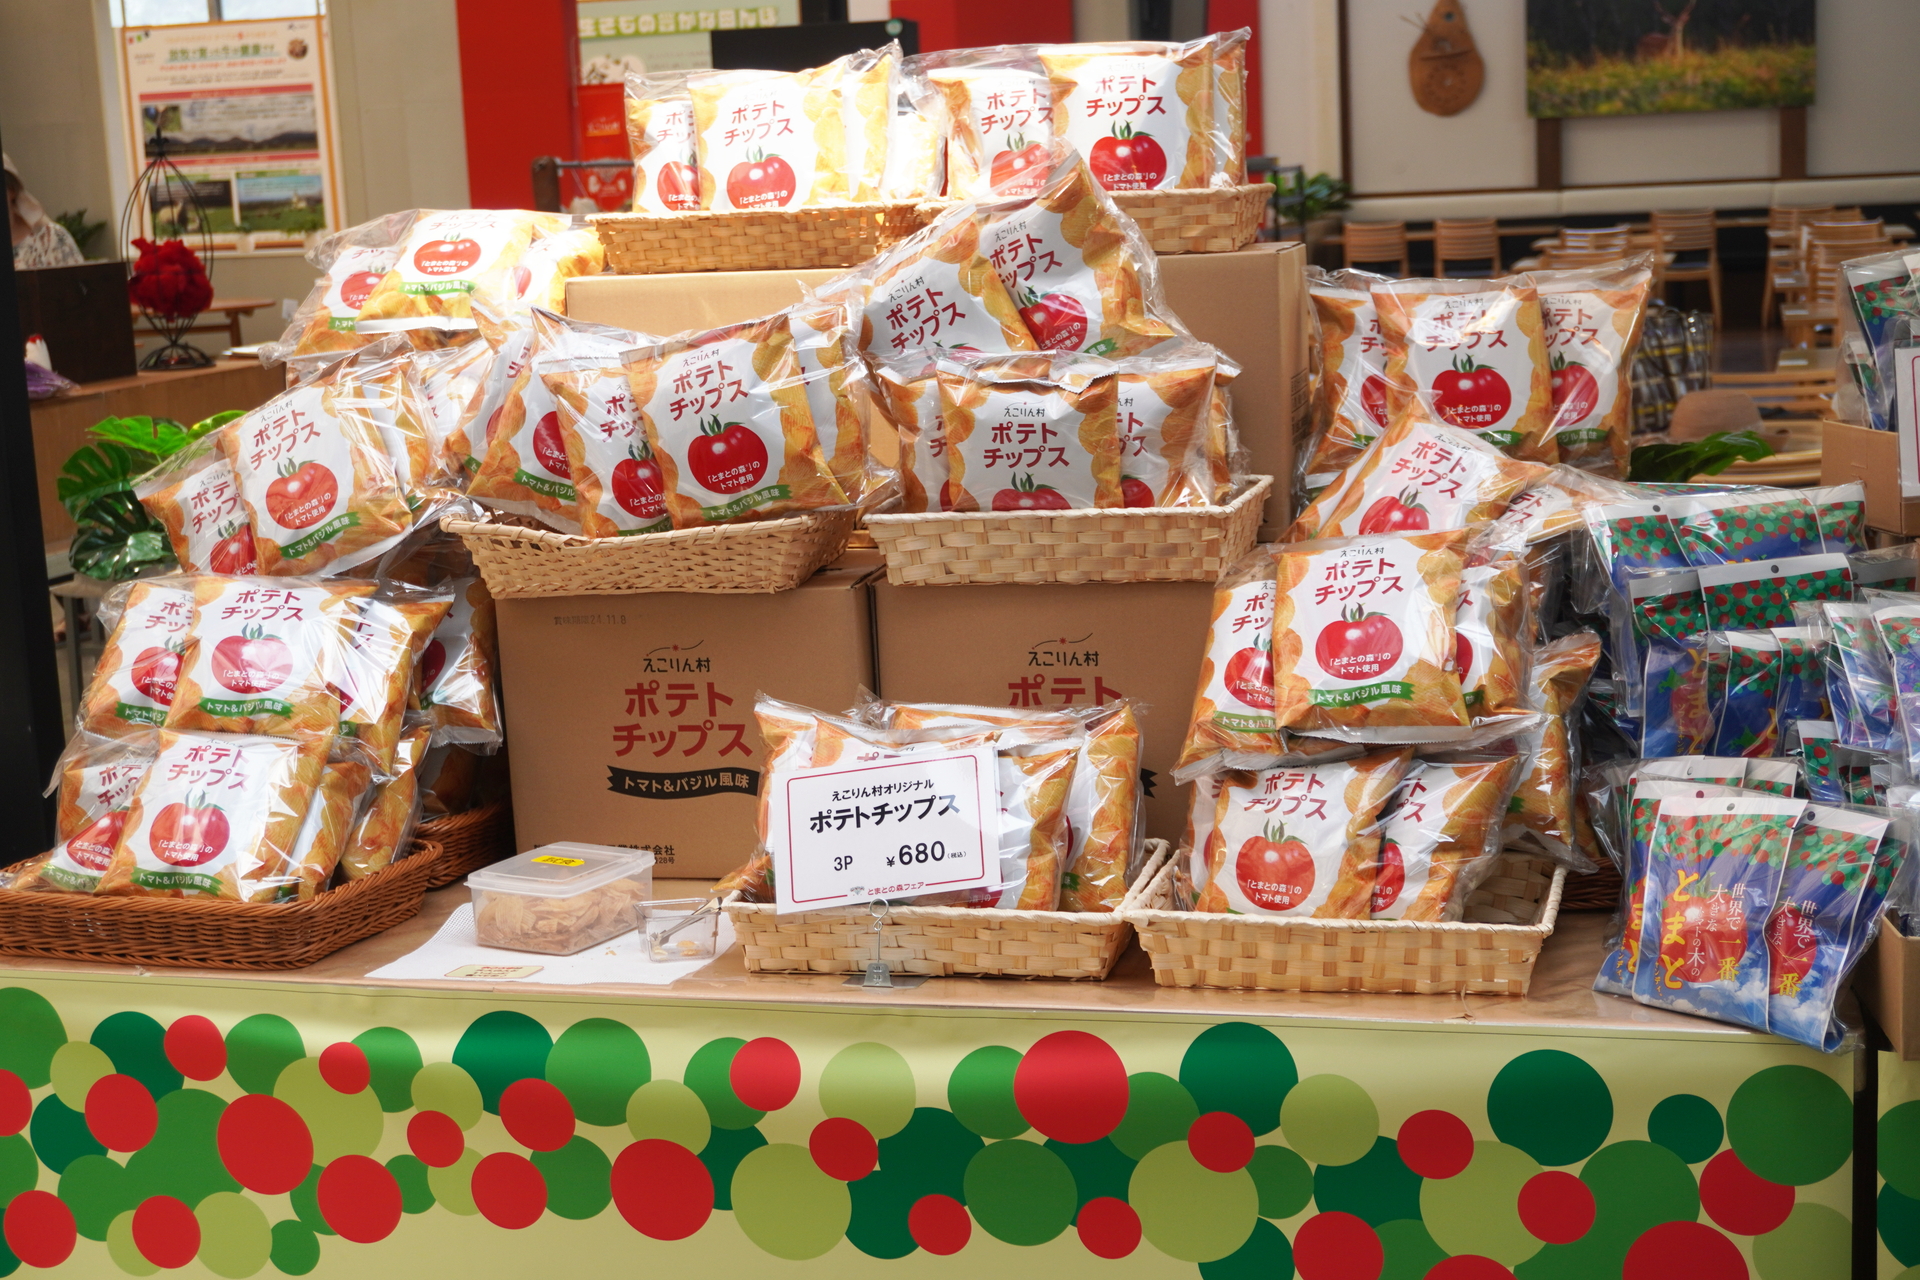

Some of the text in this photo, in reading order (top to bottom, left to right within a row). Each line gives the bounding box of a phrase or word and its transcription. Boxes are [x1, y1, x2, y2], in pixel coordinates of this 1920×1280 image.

[1096, 74, 1157, 94] ポテト
[987, 88, 1047, 110] ポテト
[1086, 95, 1166, 118] チップス
[730, 100, 785, 125] ポテト
[981, 105, 1053, 135] チップス
[724, 118, 794, 147] チップス
[429, 221, 496, 231] チップス
[994, 220, 1027, 242] えこりん村
[989, 233, 1043, 271] ポテト
[888, 275, 925, 303] えこりん村
[886, 288, 944, 330] ポテト
[891, 301, 966, 350] チップス
[682, 350, 720, 368] えこりん村
[673, 360, 734, 395] ポテト
[260, 400, 293, 422] えこりん村
[669, 379, 748, 422] チップス
[1004, 406, 1046, 418] えこりん村
[253, 408, 306, 448] ポテト
[1457, 414, 1492, 423] トマト使用
[992, 421, 1059, 444] ポテト
[250, 421, 321, 471] チップス
[983, 446, 1070, 469] チップス
[1411, 440, 1468, 474] ポテト
[720, 473, 754, 491] トマト使用
[1391, 458, 1463, 499] チップス
[710, 487, 780, 518] トマト&バジル風味
[295, 505, 326, 526] トマト使用
[288, 516, 351, 557] トマト&バジル風味
[1340, 547, 1385, 559] えこりん村
[1325, 558, 1397, 582] ポテト
[238, 588, 302, 606] ポテト
[1315, 574, 1405, 606] チップス
[221, 605, 304, 622] チップス
[642, 656, 711, 674] えこりん村
[1028, 650, 1100, 667] えこりん村
[1340, 664, 1379, 675] トマト使用
[231, 679, 267, 688] トマト使用
[1008, 673, 1123, 708] ポテト
[1316, 684, 1402, 703] トマト&バジル風味
[207, 700, 284, 712] トマト&バジル風味
[624, 679, 734, 718] ポテト
[612, 719, 753, 758] チップス
[184, 745, 250, 768] ポテト
[167, 764, 250, 793] チップス
[623, 770, 750, 794] トマト&バジル風味
[832, 778, 935, 802] えこりん村オリジナル
[1264, 771, 1326, 795] ポテト
[809, 793, 961, 834] ポテトチップス
[1243, 794, 1328, 821] チップス
[164, 851, 200, 862] トマト使用
[833, 855, 854, 872] 3P
[139, 872, 212, 888] トマト&バジル風味
[866, 881, 925, 896] とまとの森フェア
[1255, 892, 1290, 905] トマト使用
[1706, 883, 1728, 932] 大きな
[1661, 868, 1700, 990] とまと
[1772, 895, 1797, 946] 大きな
